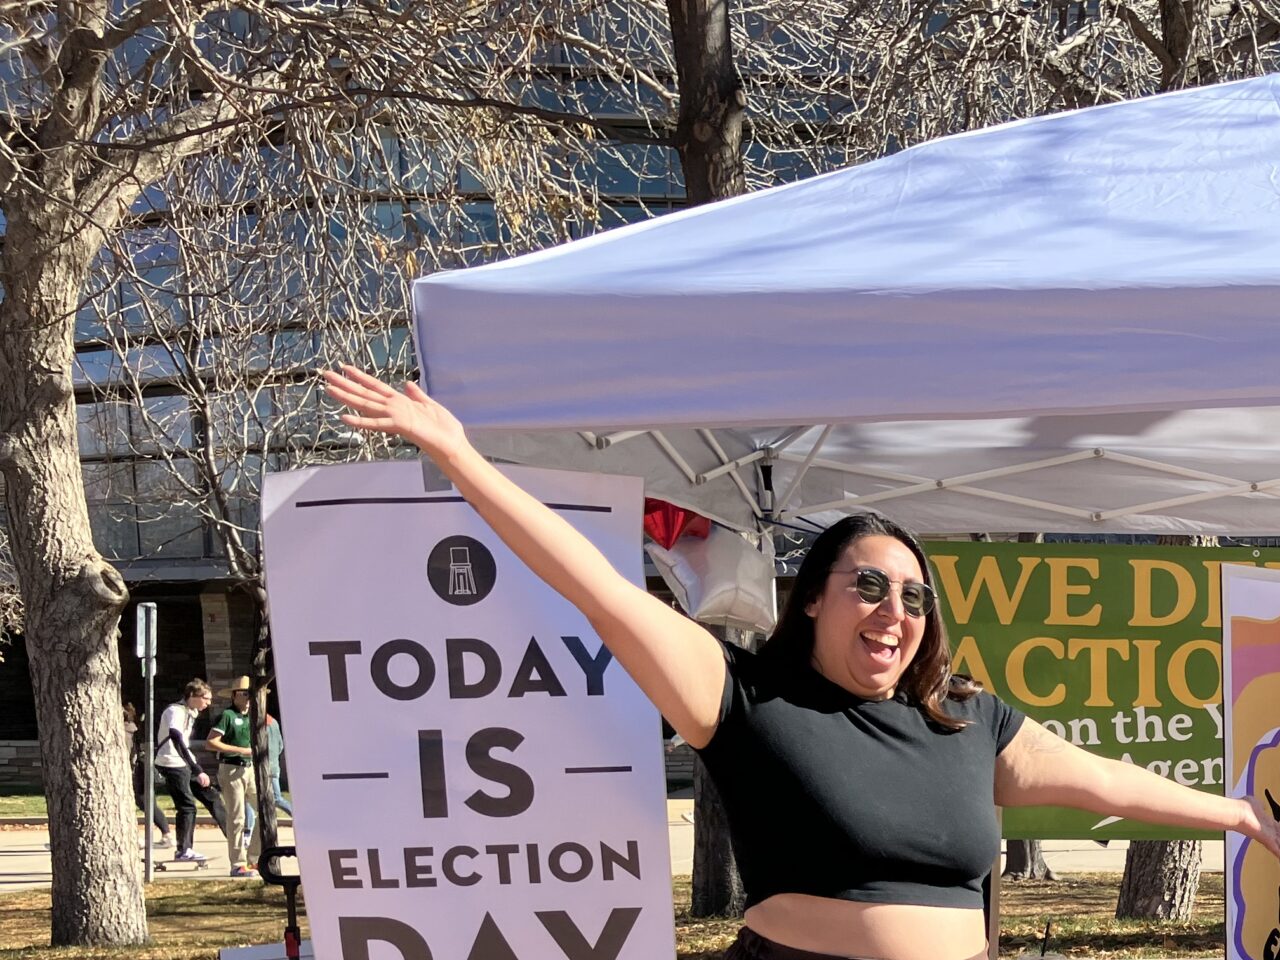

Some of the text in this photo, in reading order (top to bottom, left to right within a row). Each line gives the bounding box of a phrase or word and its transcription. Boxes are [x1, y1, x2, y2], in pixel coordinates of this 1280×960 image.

[929, 555, 1103, 626] WE
[308, 635, 614, 702] TODAY
[950, 636, 1222, 709] ACTIO
[1111, 706, 1193, 743] the
[417, 726, 535, 819] IS
[328, 840, 641, 889] ELECTION
